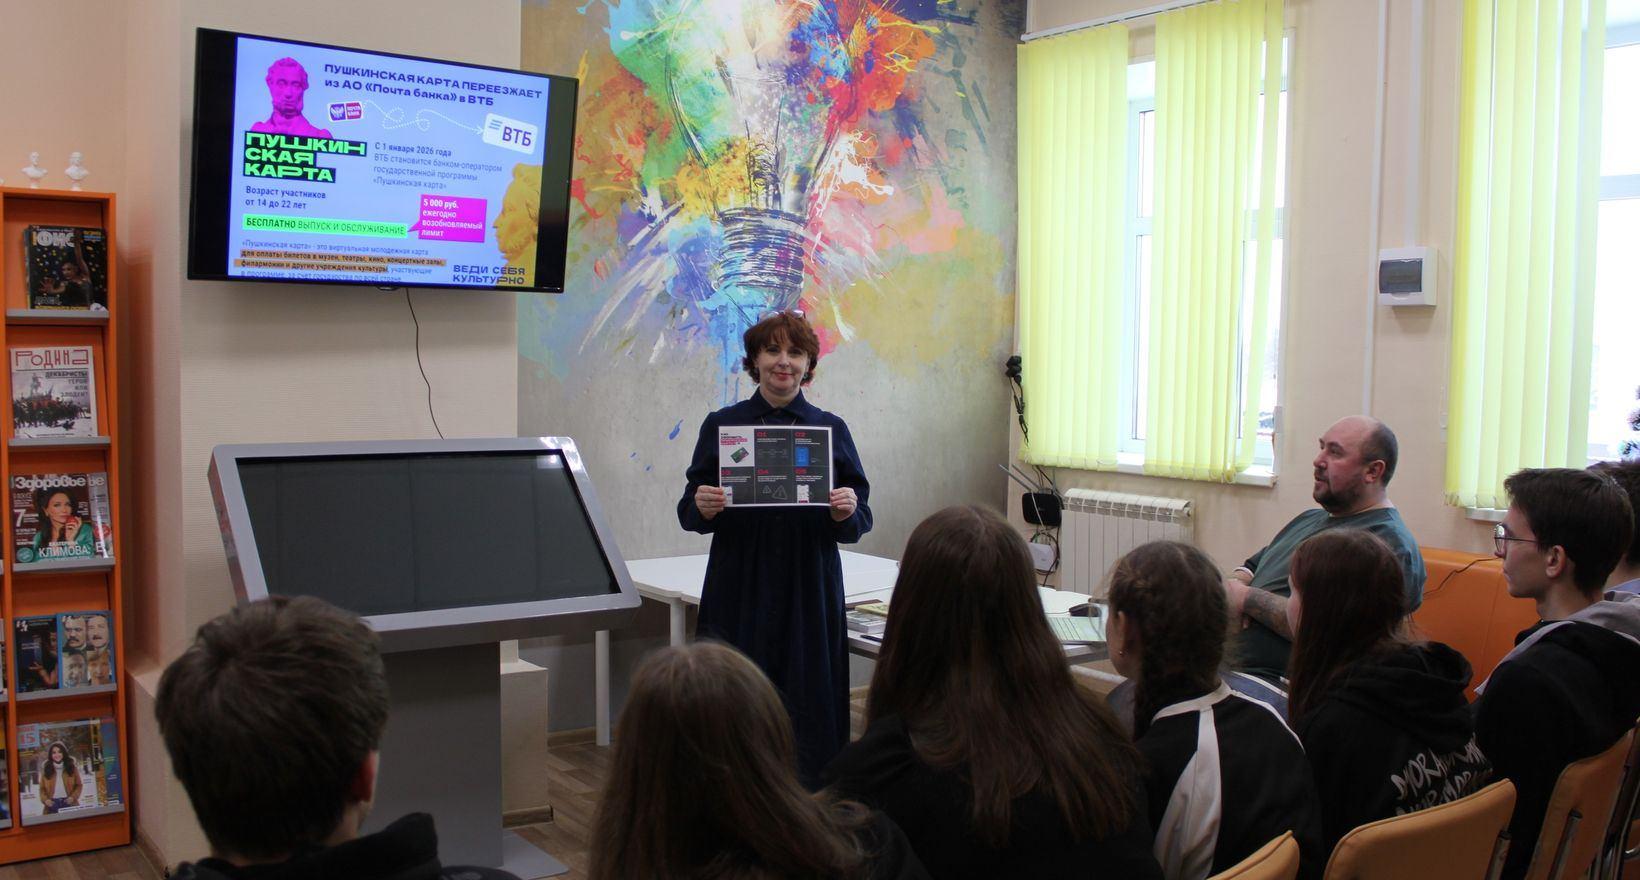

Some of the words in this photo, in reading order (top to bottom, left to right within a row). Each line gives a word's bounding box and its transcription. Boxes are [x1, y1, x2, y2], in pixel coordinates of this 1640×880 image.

[324, 63, 415, 83] ПУШКИНСКАЯ
[417, 76, 460, 89] КАРТА
[462, 81, 543, 99] ПЕРЕЕЗЖАЕТ
[324, 79, 340, 88] из
[342, 79, 363, 91] АО
[365, 82, 411, 96] «Почта
[413, 88, 457, 101] банка»
[459, 95, 466, 103] в
[468, 95, 494, 106] ВТБ
[246, 132, 366, 155] ПУШКИН
[502, 126, 533, 147] ВТБ
[245, 147, 315, 165] СКАЯ
[375, 141, 381, 150] С
[383, 143, 387, 151] 1
[388, 145, 415, 154] января
[416, 145, 434, 155] 2026
[435, 148, 452, 157] года
[374, 153, 389, 162] ВТБ
[390, 157, 432, 166] становится
[433, 160, 503, 172] банком-оператором
[244, 162, 334, 182] КАРТА
[373, 166, 436, 178] государственной
[437, 170, 478, 181] программы
[373, 176, 422, 188] «Пушкинская
[423, 182, 447, 190] карта»
[246, 185, 279, 196] Возраст
[280, 189, 327, 199] участников
[257, 198, 267, 206] 14
[268, 201, 280, 209] до
[281, 200, 291, 208] 22
[423, 198, 429, 207] 5
[429, 199, 444, 208] 000
[444, 201, 459, 210] руб.
[422, 210, 457, 219] ежегодно
[246, 217, 296, 229] БЕСПЛАТНО
[297, 220, 333, 231] ВЫПУСК
[333, 223, 339, 231] И
[341, 223, 405, 235] ОБСЛУЖИВАНИЕ
[421, 219, 483, 230] возобновляемый
[421, 229, 444, 237] лимит
[241, 250, 254, 258] для
[283, 251, 311, 259] билетов
[453, 264, 489, 275] ВЕДИ
[492, 266, 526, 276] СЕБЯ
[452, 274, 525, 285] КУЛЬТУРНО
[15, 475, 86, 492] Здоровье
[13, 508, 26, 527] 7
